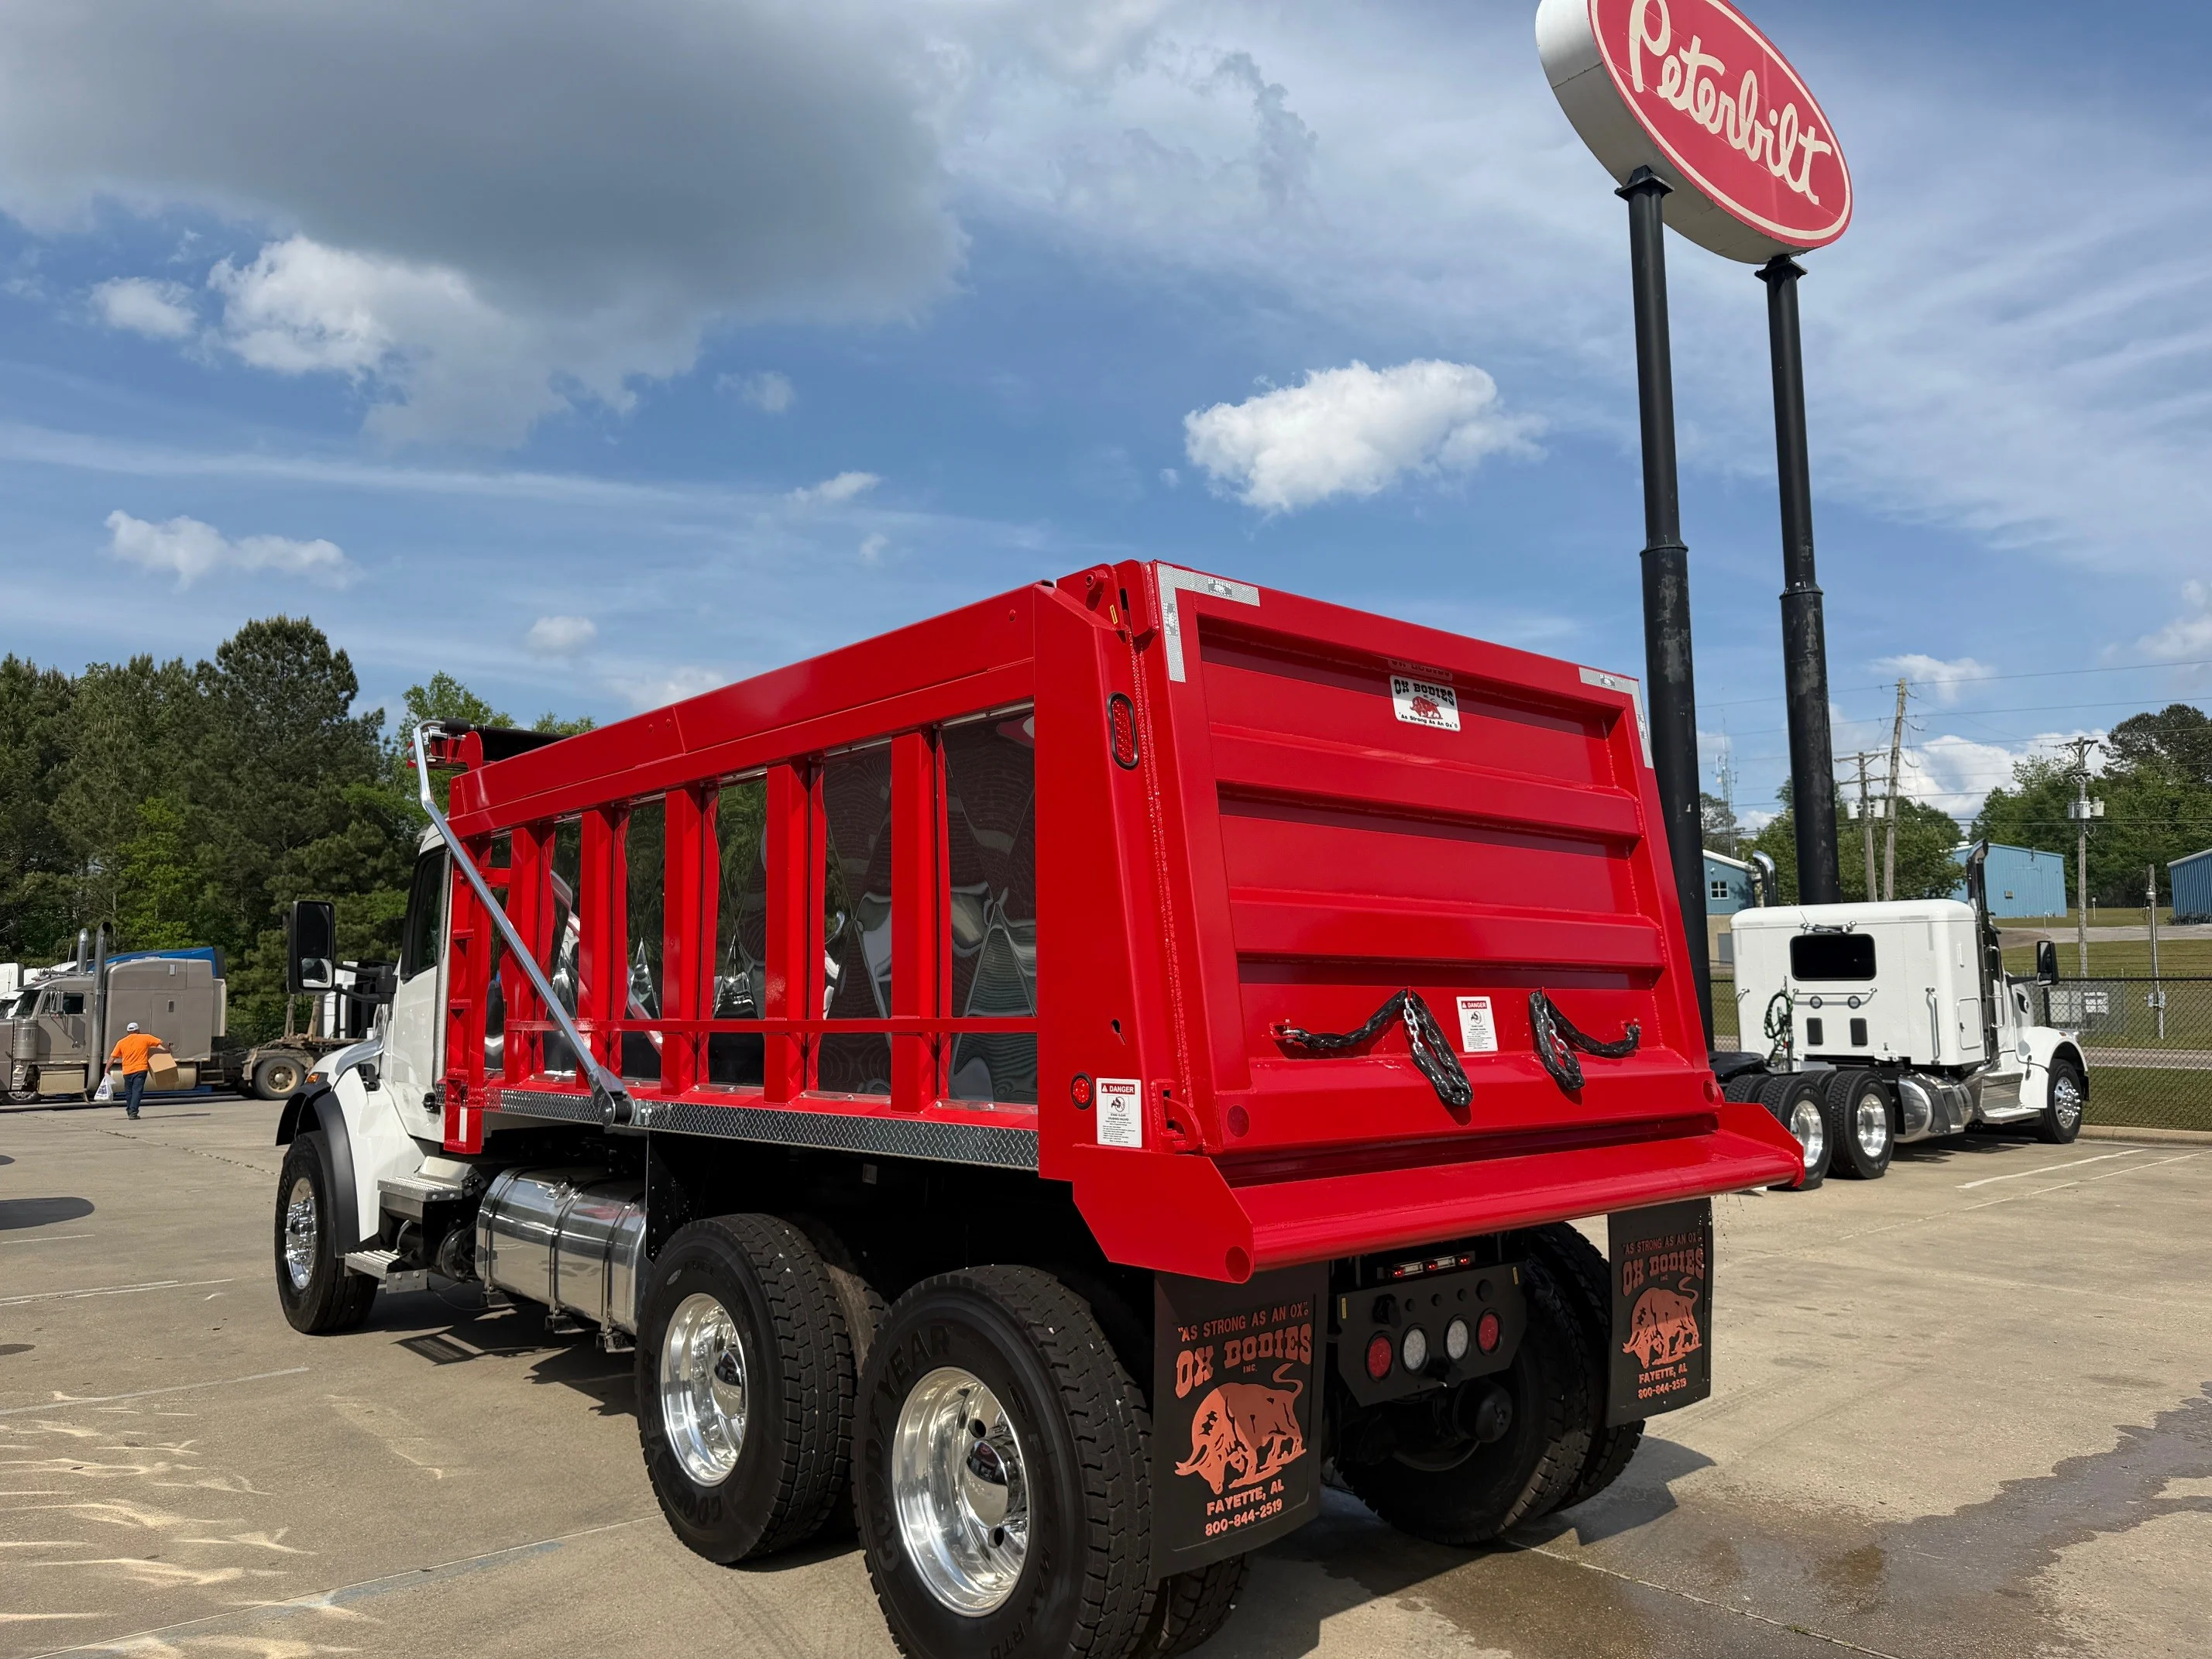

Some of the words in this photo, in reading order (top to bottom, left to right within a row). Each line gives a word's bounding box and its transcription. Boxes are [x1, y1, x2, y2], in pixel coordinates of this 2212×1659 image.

[1629, 0, 1832, 205] Peterbilt
[1394, 679, 1409, 695] OX
[1413, 683, 1455, 706] BODIES
[1637, 1238, 1662, 1253] STRONG
[1665, 1235, 1674, 1248] AS
[1677, 1233, 1685, 1245] AN
[1623, 1259, 1644, 1297] OX
[1649, 1248, 1704, 1281] BODIES
[1203, 1315, 1246, 1338] STRONG
[1252, 1310, 1266, 1327] AS
[1272, 1306, 1286, 1323] AN
[1175, 1345, 1214, 1399] OX
[1224, 1323, 1312, 1369] BODIES
[1638, 1366, 1676, 1384] FAYETTE,
[1678, 1363, 1688, 1374] AL
[1638, 1377, 1687, 1400] 800-844-2519
[1207, 1486, 1266, 1516] FAYETTE,
[1271, 1479, 1285, 1495] AL
[1205, 1498, 1283, 1537] 800-844-2519
